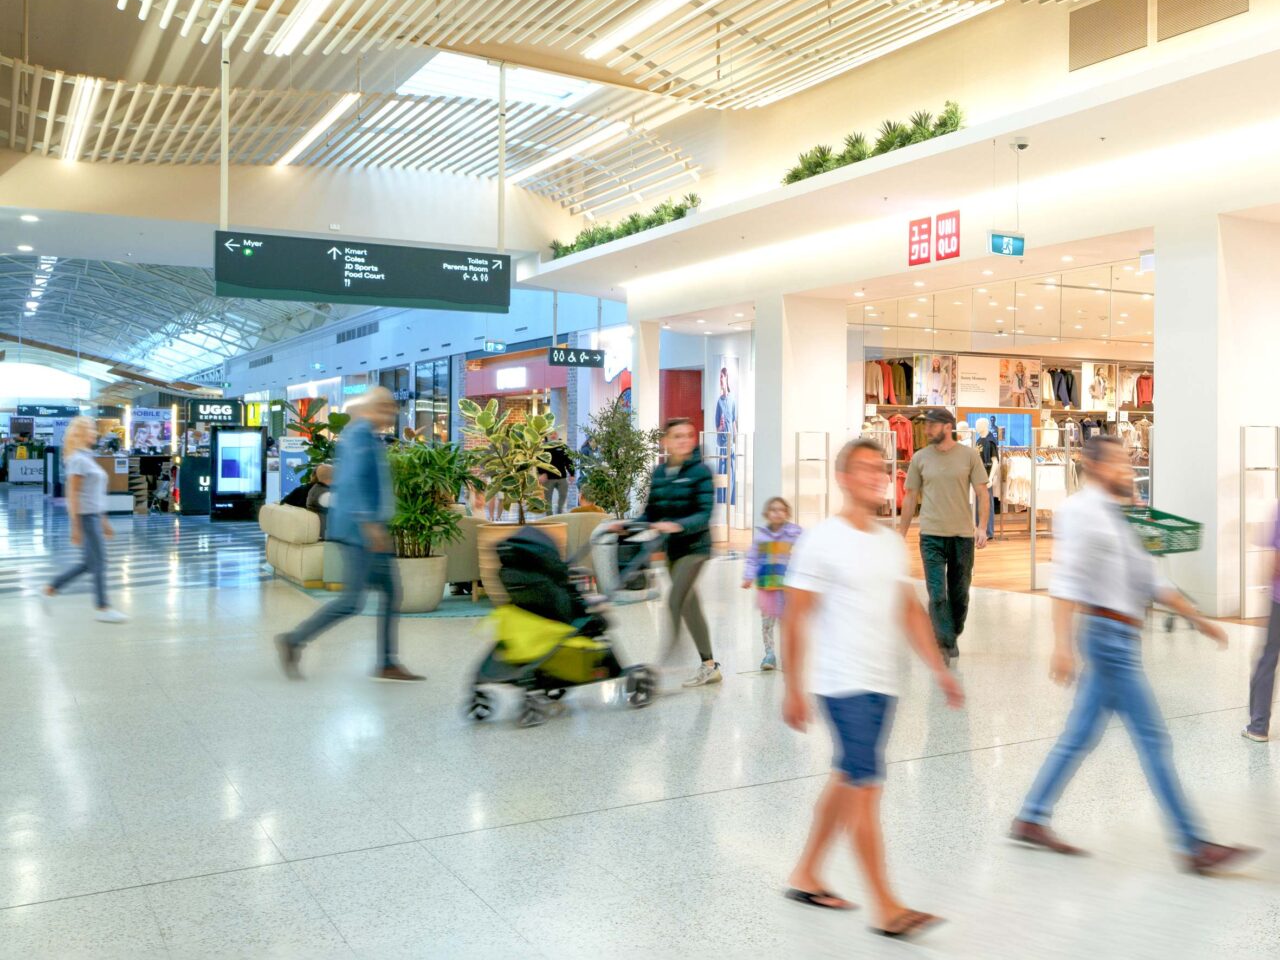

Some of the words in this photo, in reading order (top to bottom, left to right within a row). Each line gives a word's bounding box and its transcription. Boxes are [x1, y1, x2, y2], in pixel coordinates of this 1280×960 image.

[938, 217, 956, 236] UNI
[243, 239, 263, 248] Myer
[938, 236, 958, 257] QLO
[344, 247, 367, 256] Kmart
[467, 257, 488, 265] Toilets
[344, 263, 353, 271] JD
[354, 264, 378, 272] Sports
[442, 263, 468, 272] Parents
[468, 265, 488, 273] Room
[344, 271, 363, 279] Food
[364, 272, 385, 280] Court
[199, 405, 232, 415] UGG
